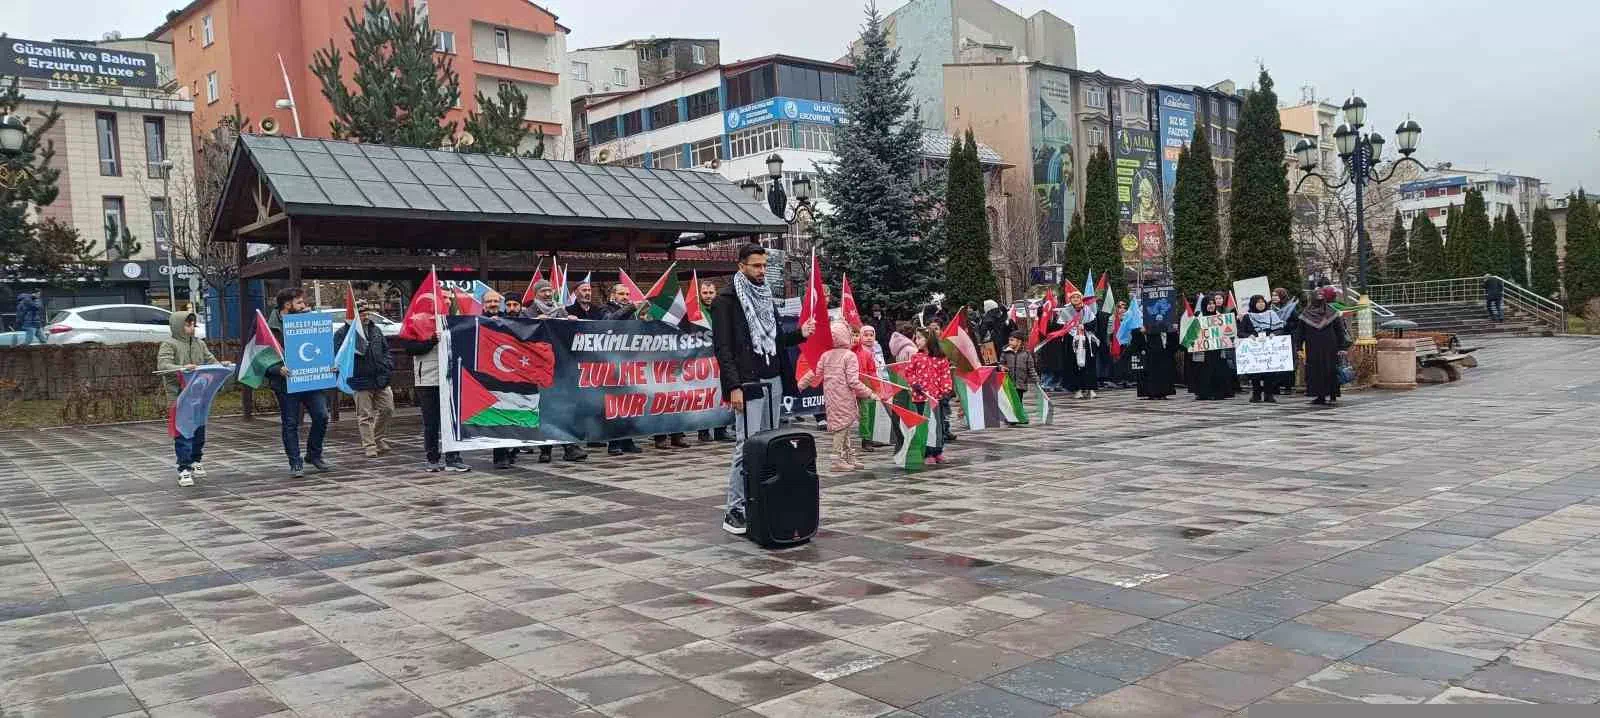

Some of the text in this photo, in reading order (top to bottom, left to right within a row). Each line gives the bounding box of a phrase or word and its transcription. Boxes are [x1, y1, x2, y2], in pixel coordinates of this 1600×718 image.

[12, 42, 147, 67] Güzellik ve Bakım
[28, 57, 134, 77] Erzurum Luxe
[52, 72, 80, 83] 444
[95, 75, 119, 86] 312
[800, 112, 831, 121] ERZURUM
[570, 329, 713, 352] HEKİMLERDEN SESS
[578, 354, 720, 388] ZULME VE SOY
[604, 391, 648, 420] DUR
[650, 386, 718, 416] DEMEK
